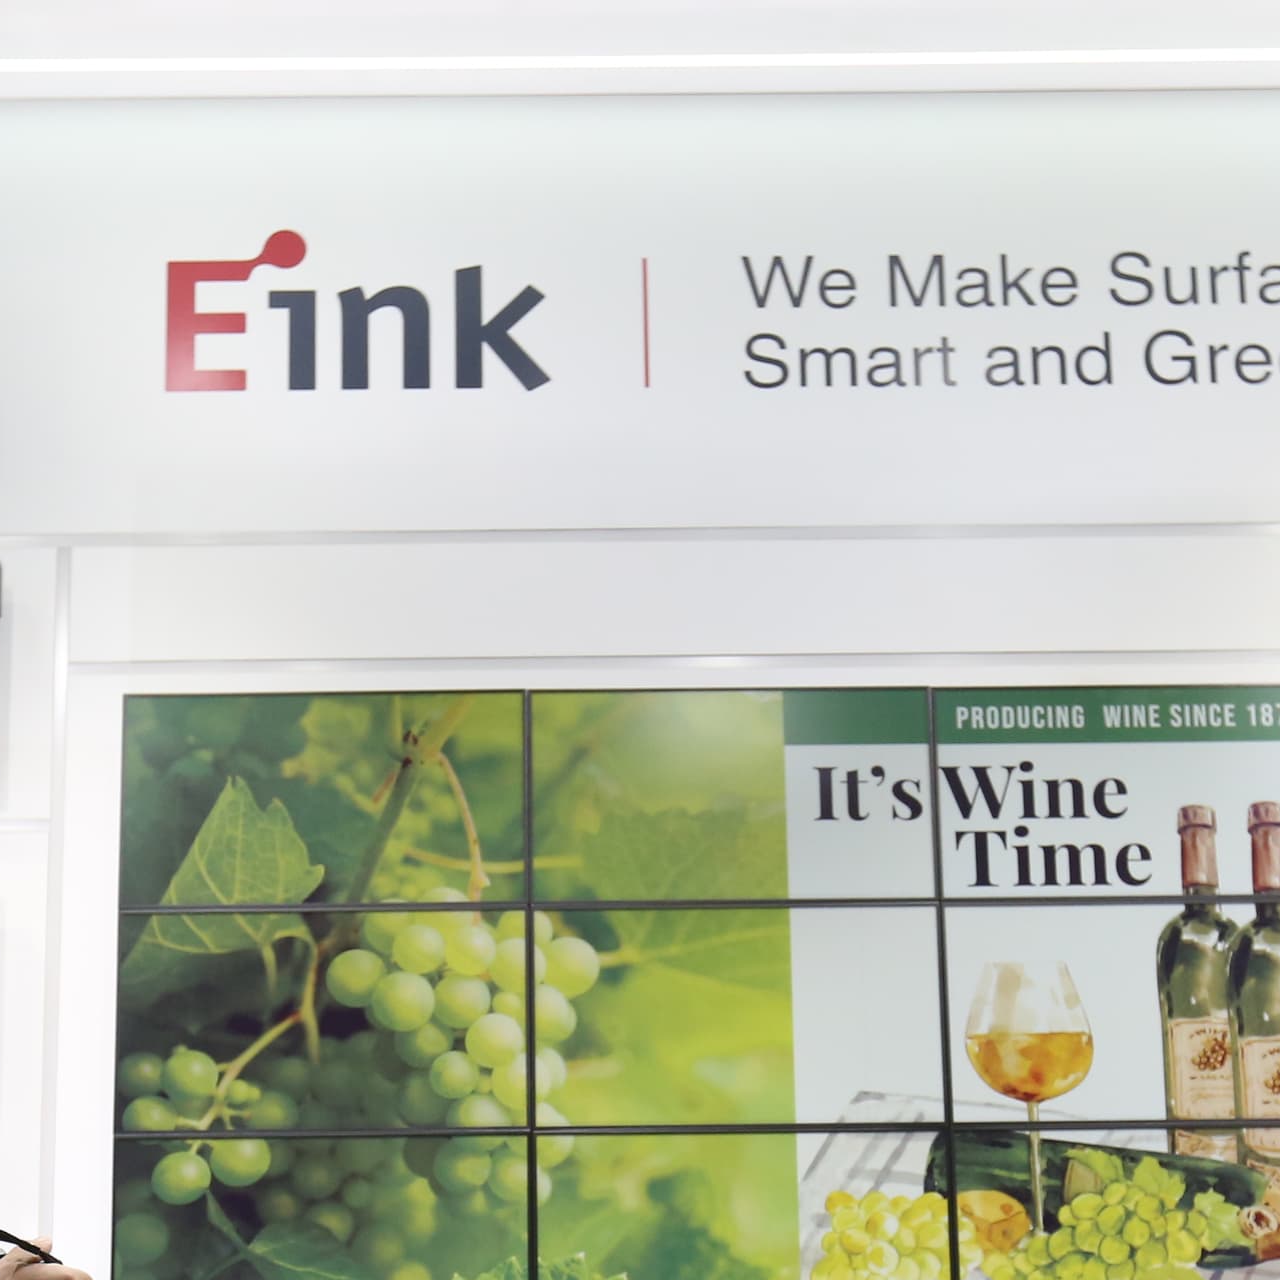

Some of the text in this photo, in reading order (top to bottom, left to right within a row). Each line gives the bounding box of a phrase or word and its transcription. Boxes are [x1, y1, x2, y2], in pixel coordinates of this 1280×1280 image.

[742, 255, 857, 308] We
[888, 252, 1079, 308] Make
[743, 331, 957, 388] Smart
[984, 330, 1114, 385] and
[956, 705, 1085, 729] PRODUCING
[1104, 705, 1160, 728] WINE
[1170, 704, 1235, 728] SINCE
[813, 762, 1128, 821] It's Wine
[956, 826, 1152, 886] Time
